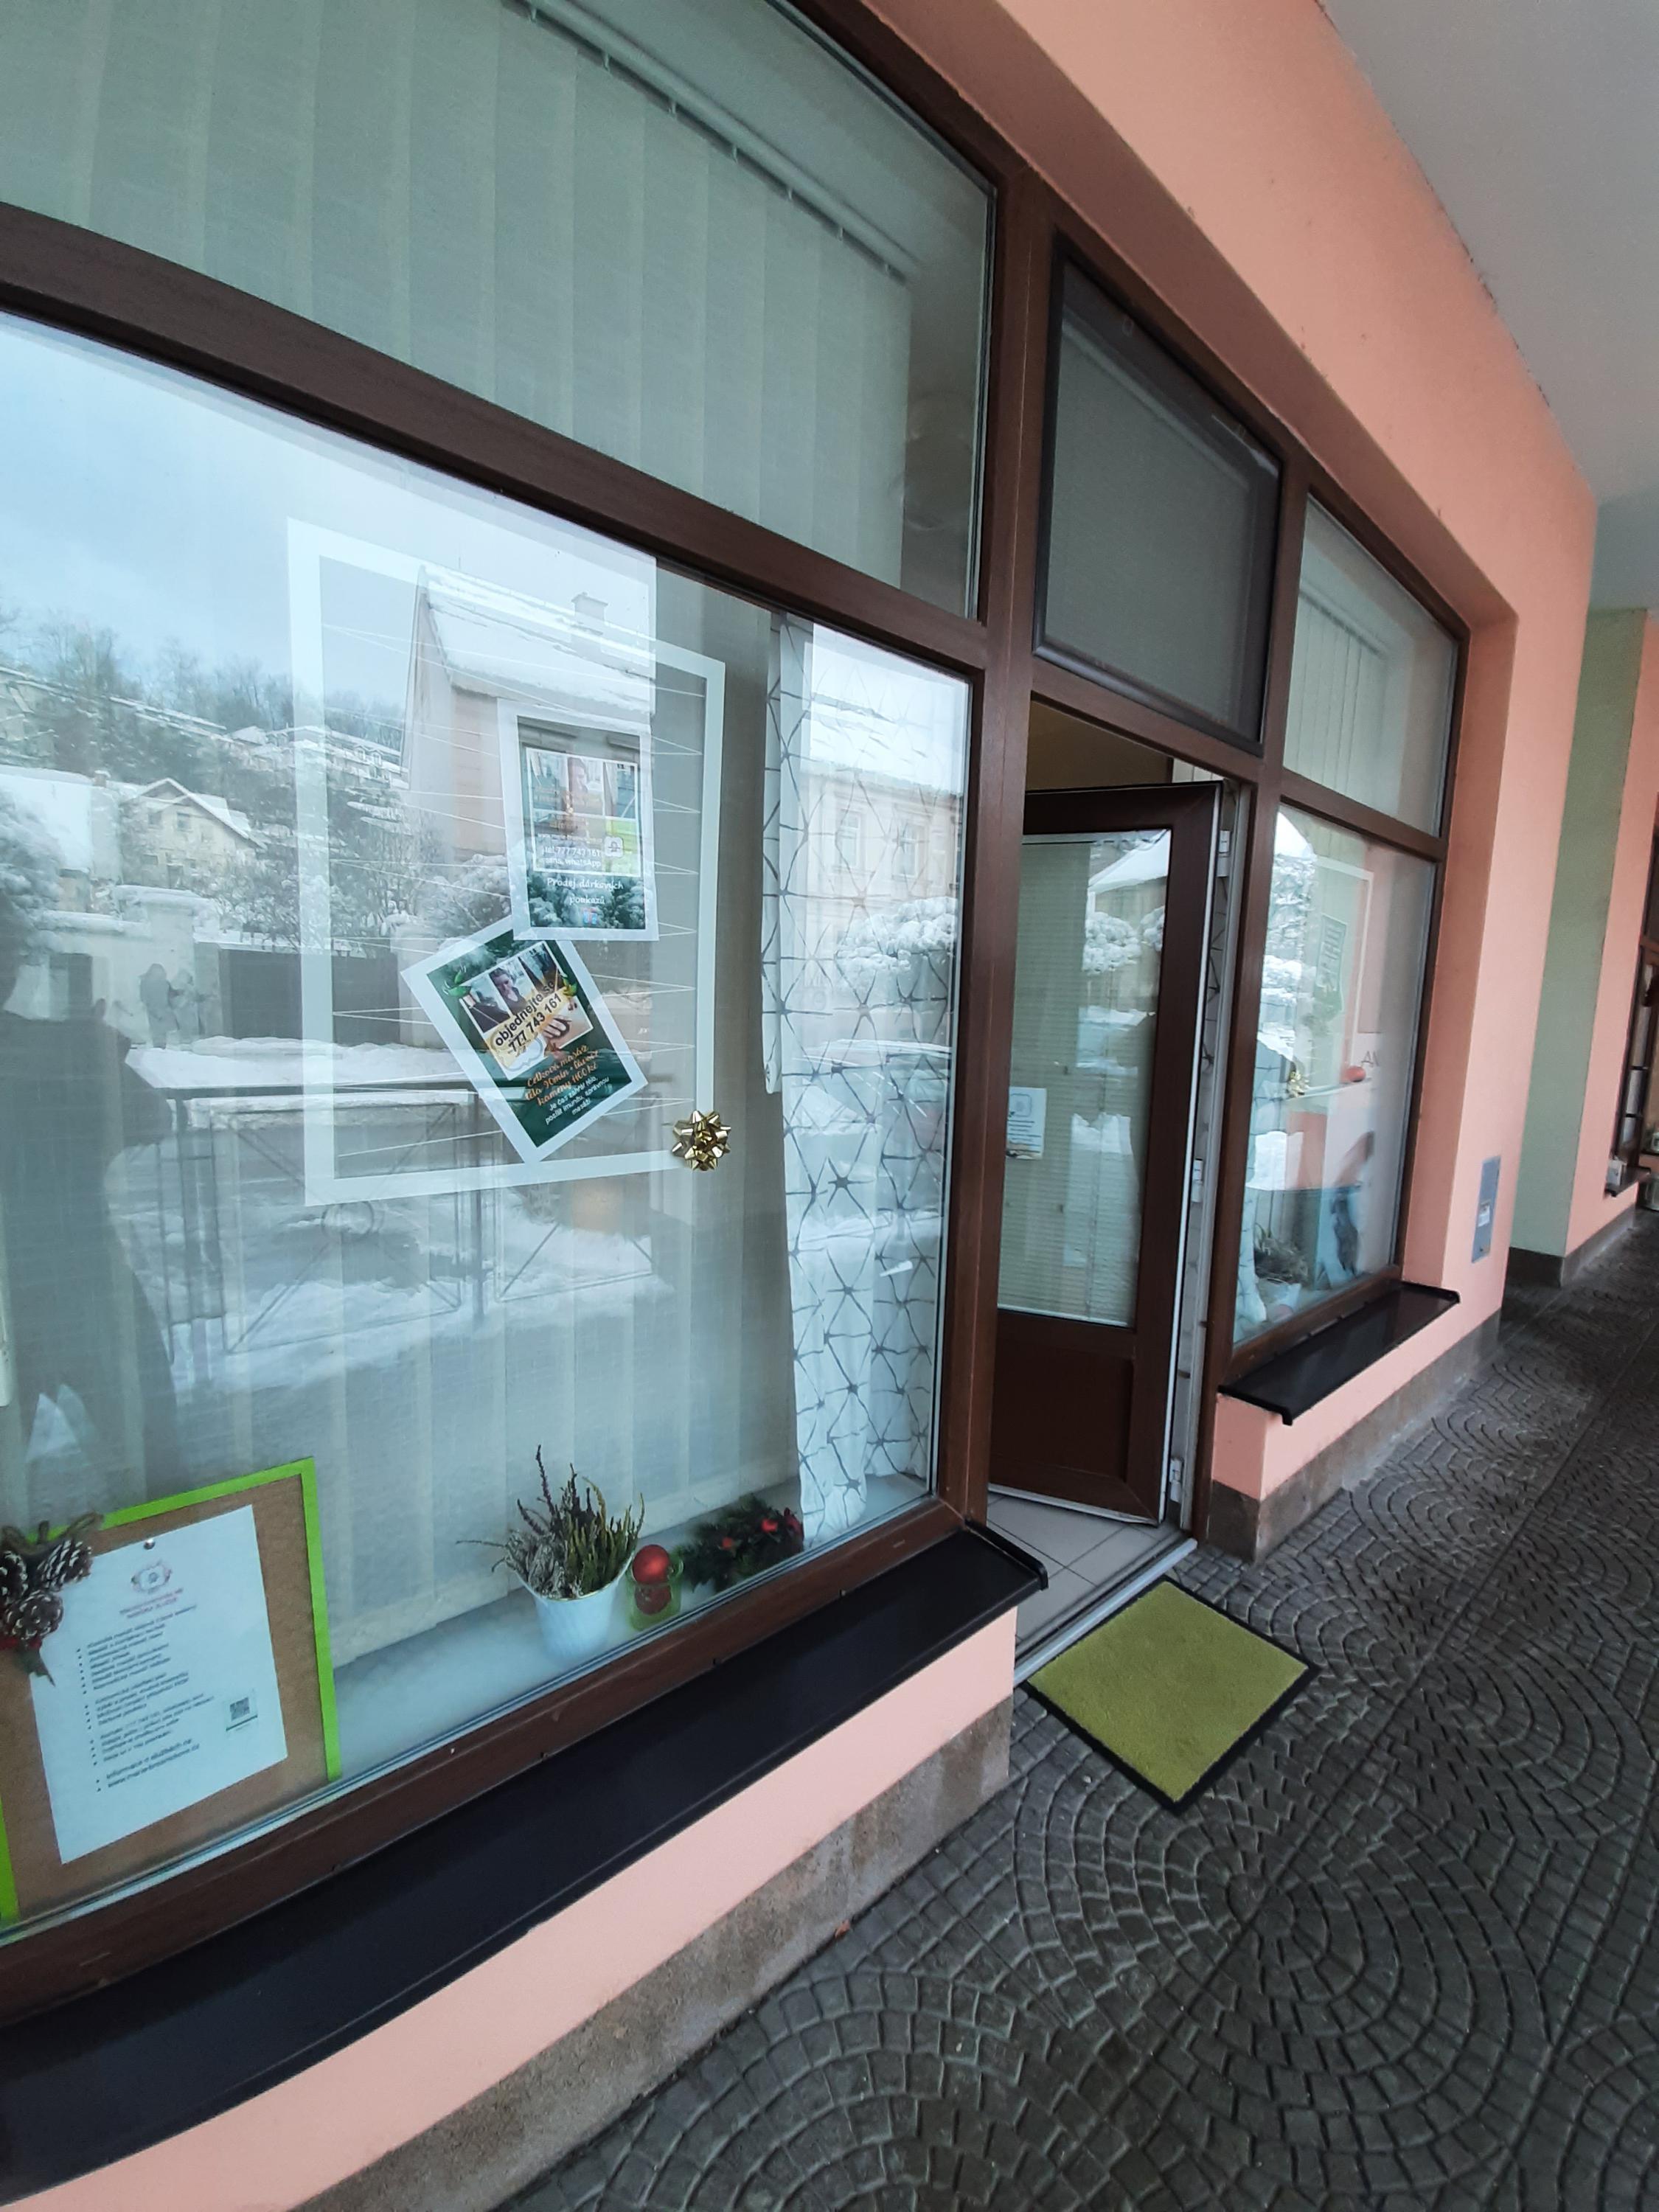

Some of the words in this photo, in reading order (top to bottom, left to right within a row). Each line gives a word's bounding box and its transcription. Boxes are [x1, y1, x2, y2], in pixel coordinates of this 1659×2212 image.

[572, 847, 585, 856] 743
[547, 877, 576, 889] Prodej
[579, 878, 624, 892] dárkových
[569, 894, 605, 905] poukazů
[495, 993, 543, 1046] objednejte
[543, 981, 554, 994] se
[508, 1029, 527, 1052] 777
[526, 1012, 546, 1033] 743
[545, 993, 562, 1013] 161
